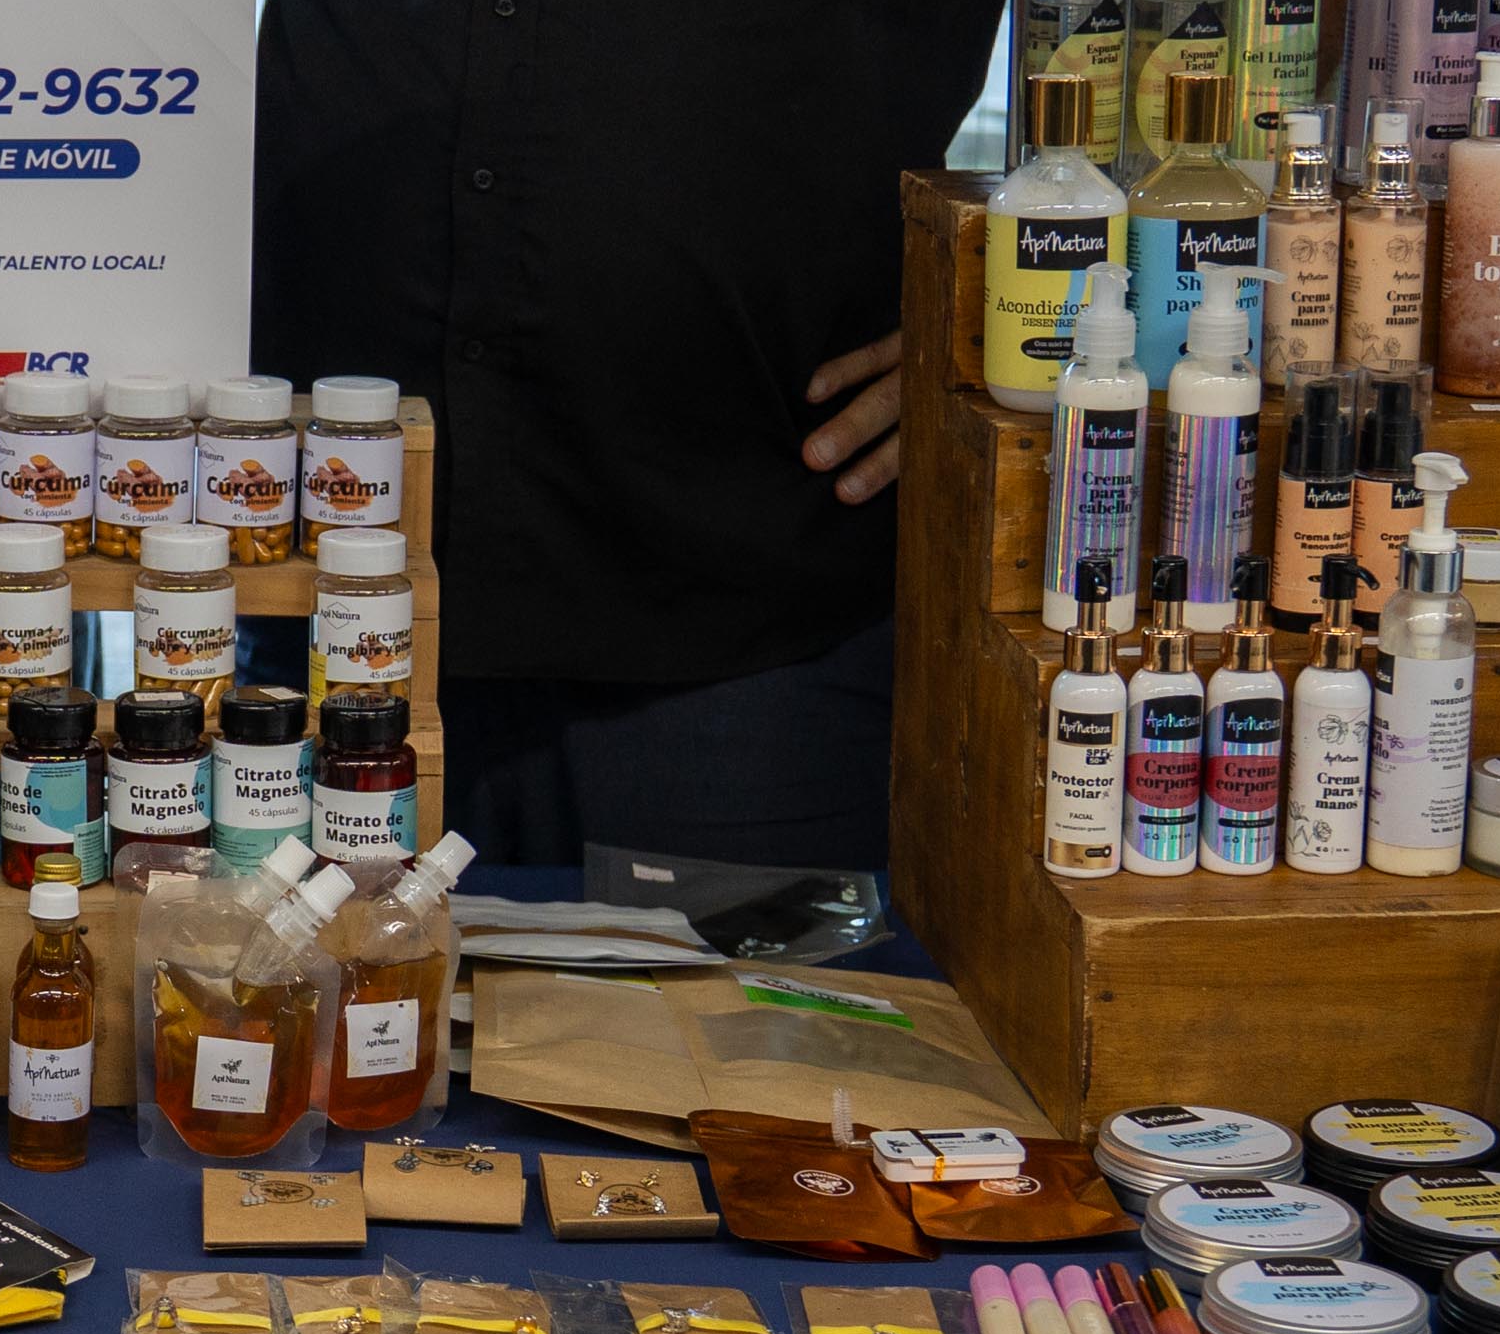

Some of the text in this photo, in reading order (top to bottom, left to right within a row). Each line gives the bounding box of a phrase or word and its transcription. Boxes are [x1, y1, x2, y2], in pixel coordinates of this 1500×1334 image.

[1242, 51, 1264, 64] Gel
[25, 143, 117, 170] MÓVIL
[91, 255, 166, 271] LOCAL!
[1474, 263, 1498, 282] to
[1291, 292, 1331, 303] Crema
[1297, 305, 1326, 316] para
[27, 352, 89, 376] BCR
[1, 470, 90, 492] Cúrcuma
[207, 474, 295, 497] Cúrcuma
[234, 765, 312, 783] Citrato de
[1051, 771, 1115, 787] Protector
[1316, 772, 1361, 785] Crema
[235, 782, 309, 802] Magnesio
[1063, 788, 1102, 800] solar
[1322, 786, 1354, 799] para
[1315, 798, 1359, 810] manos
[325, 810, 403, 827] Citrato de
[326, 827, 402, 847] Magnesio
